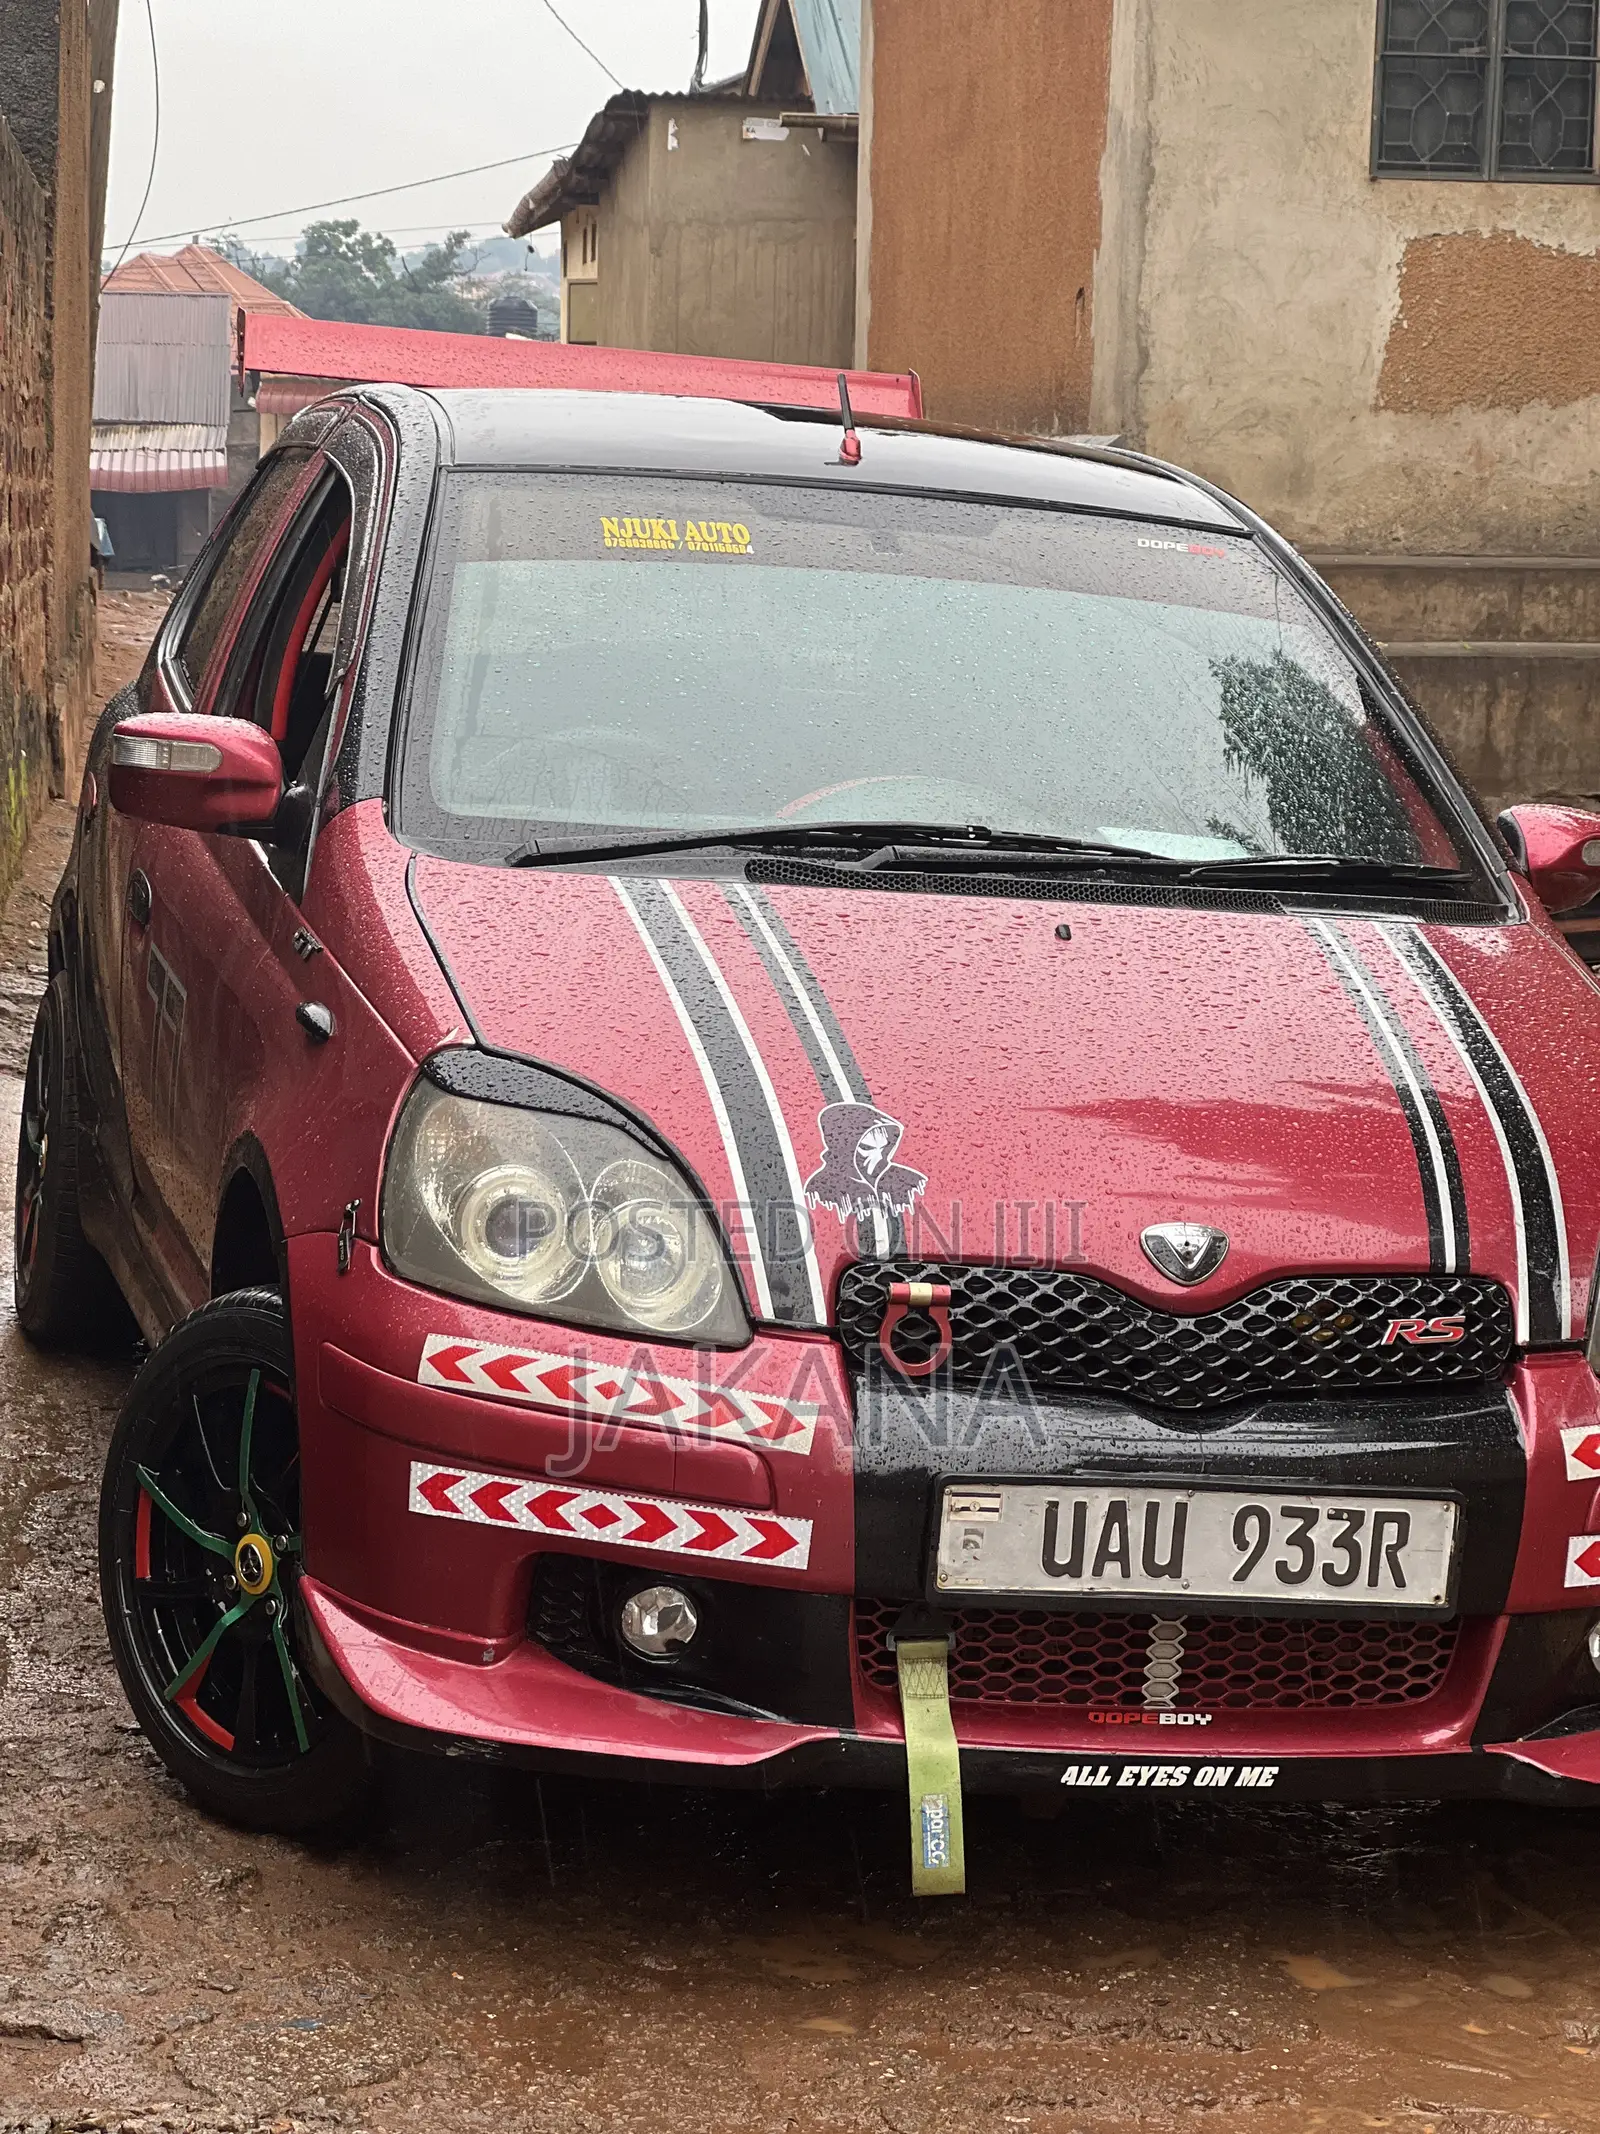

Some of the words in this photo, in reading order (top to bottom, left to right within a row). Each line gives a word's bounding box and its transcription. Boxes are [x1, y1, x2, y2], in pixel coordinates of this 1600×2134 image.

[600, 517, 680, 541] NJUKI
[685, 520, 751, 545] AUTO
[1137, 538, 1225, 559] DOPEBOY
[1381, 1316, 1465, 1346] RS
[1042, 1500, 1189, 1579] UAU
[1231, 1504, 1411, 1588] 933R
[1088, 1711, 1212, 1725] DOPEBOY
[1061, 1765, 1111, 1787] ALL
[1116, 1765, 1190, 1787] EYES
[1193, 1766, 1229, 1787] ON
[1233, 1766, 1280, 1788] ME
